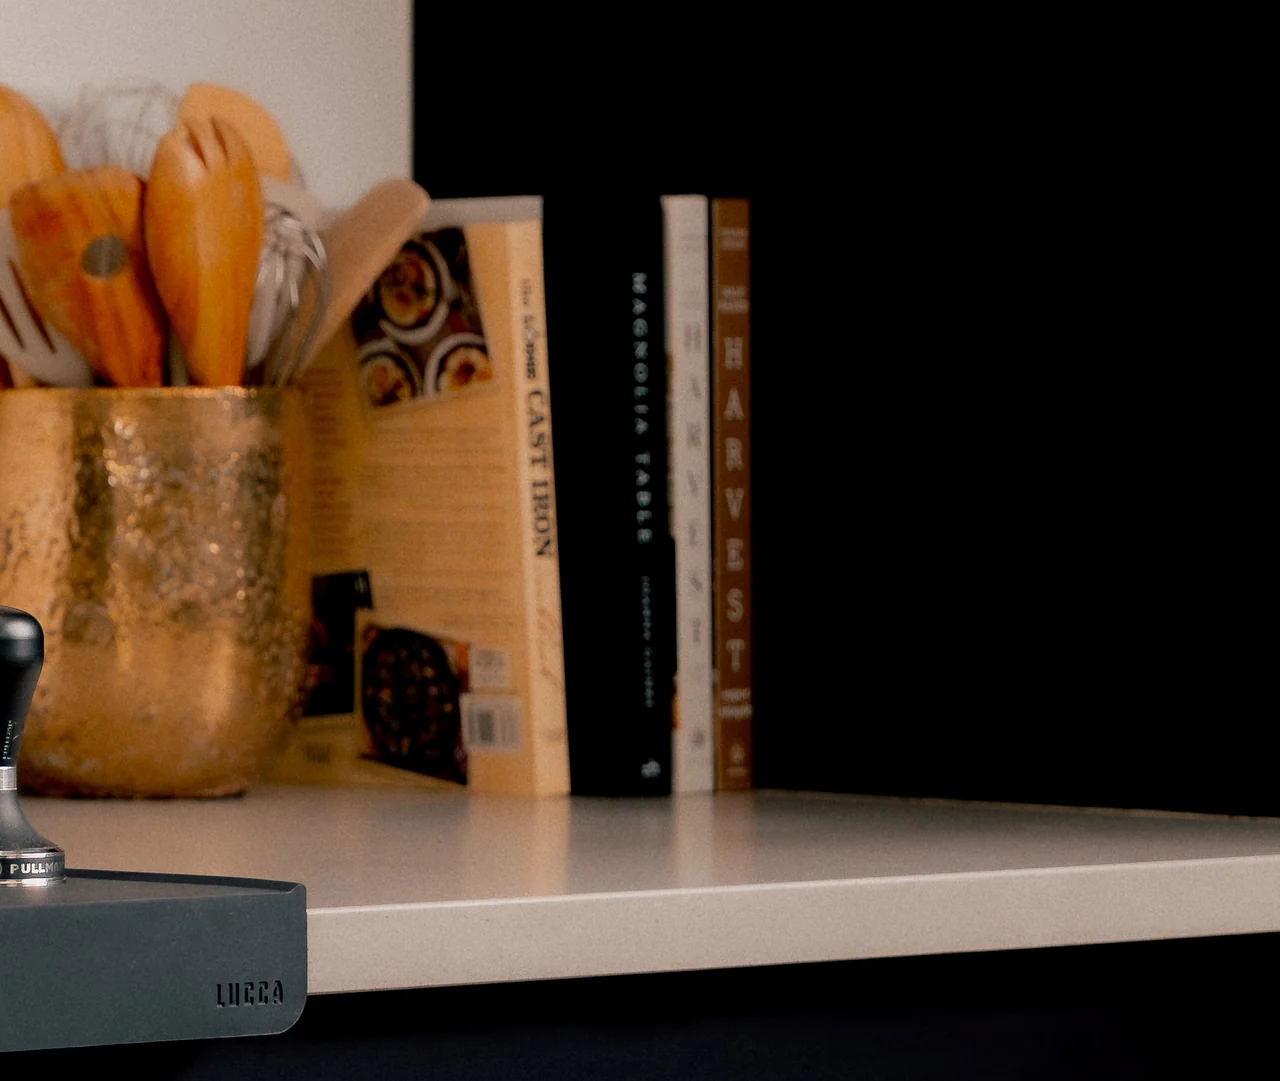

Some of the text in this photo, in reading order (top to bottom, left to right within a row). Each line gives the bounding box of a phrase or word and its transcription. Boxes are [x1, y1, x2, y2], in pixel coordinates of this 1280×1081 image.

[527, 389, 547, 469] CAST
[632, 272, 653, 544] MAGNOLIA TABLE
[532, 480, 551, 558] IRON
[724, 336, 745, 672] HARVEST
[216, 980, 284, 1008] LUCCA
